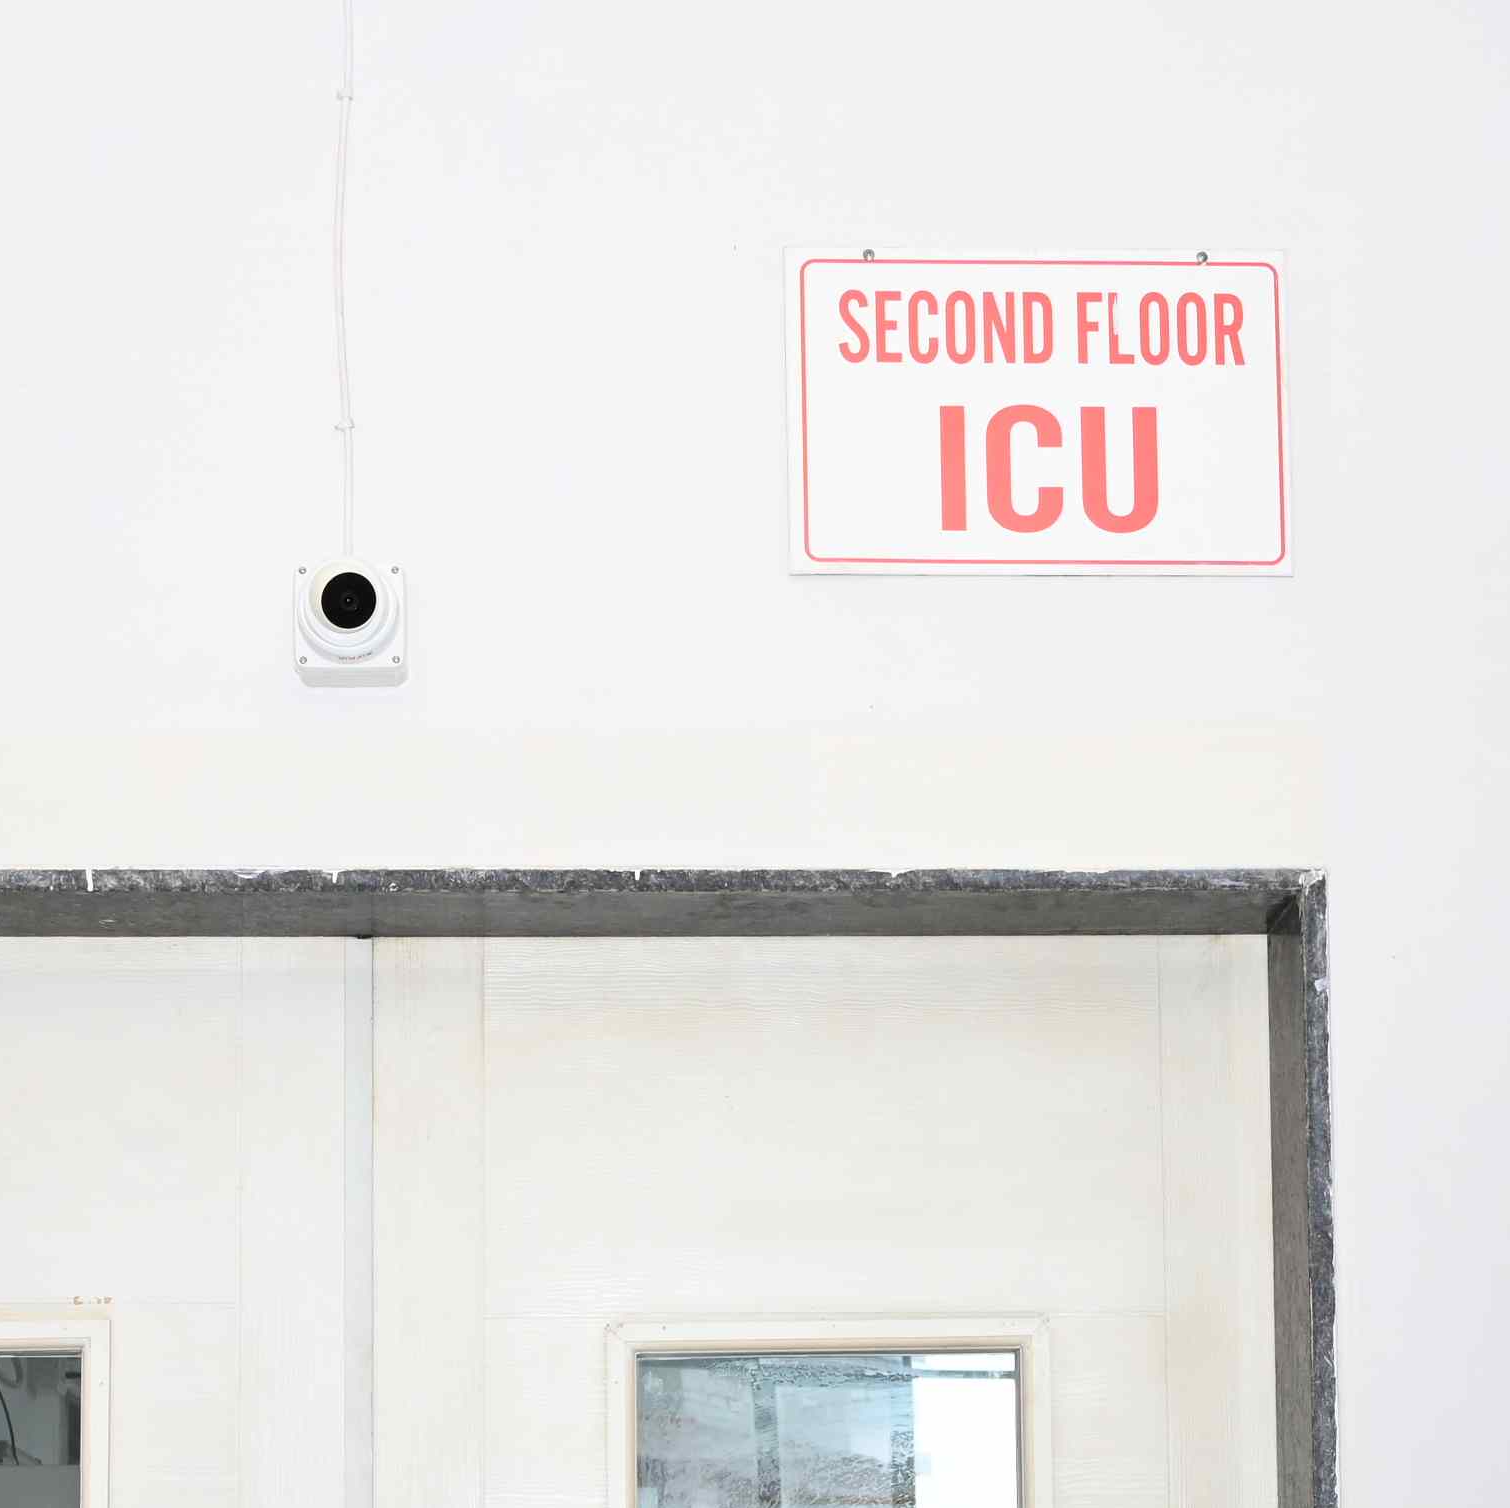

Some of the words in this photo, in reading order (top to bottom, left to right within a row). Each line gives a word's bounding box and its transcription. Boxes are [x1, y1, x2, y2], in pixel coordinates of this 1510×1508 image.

[838, 289, 1054, 364] SECOND
[1076, 291, 1245, 366] FLOOR
[940, 404, 1159, 534] ICU
